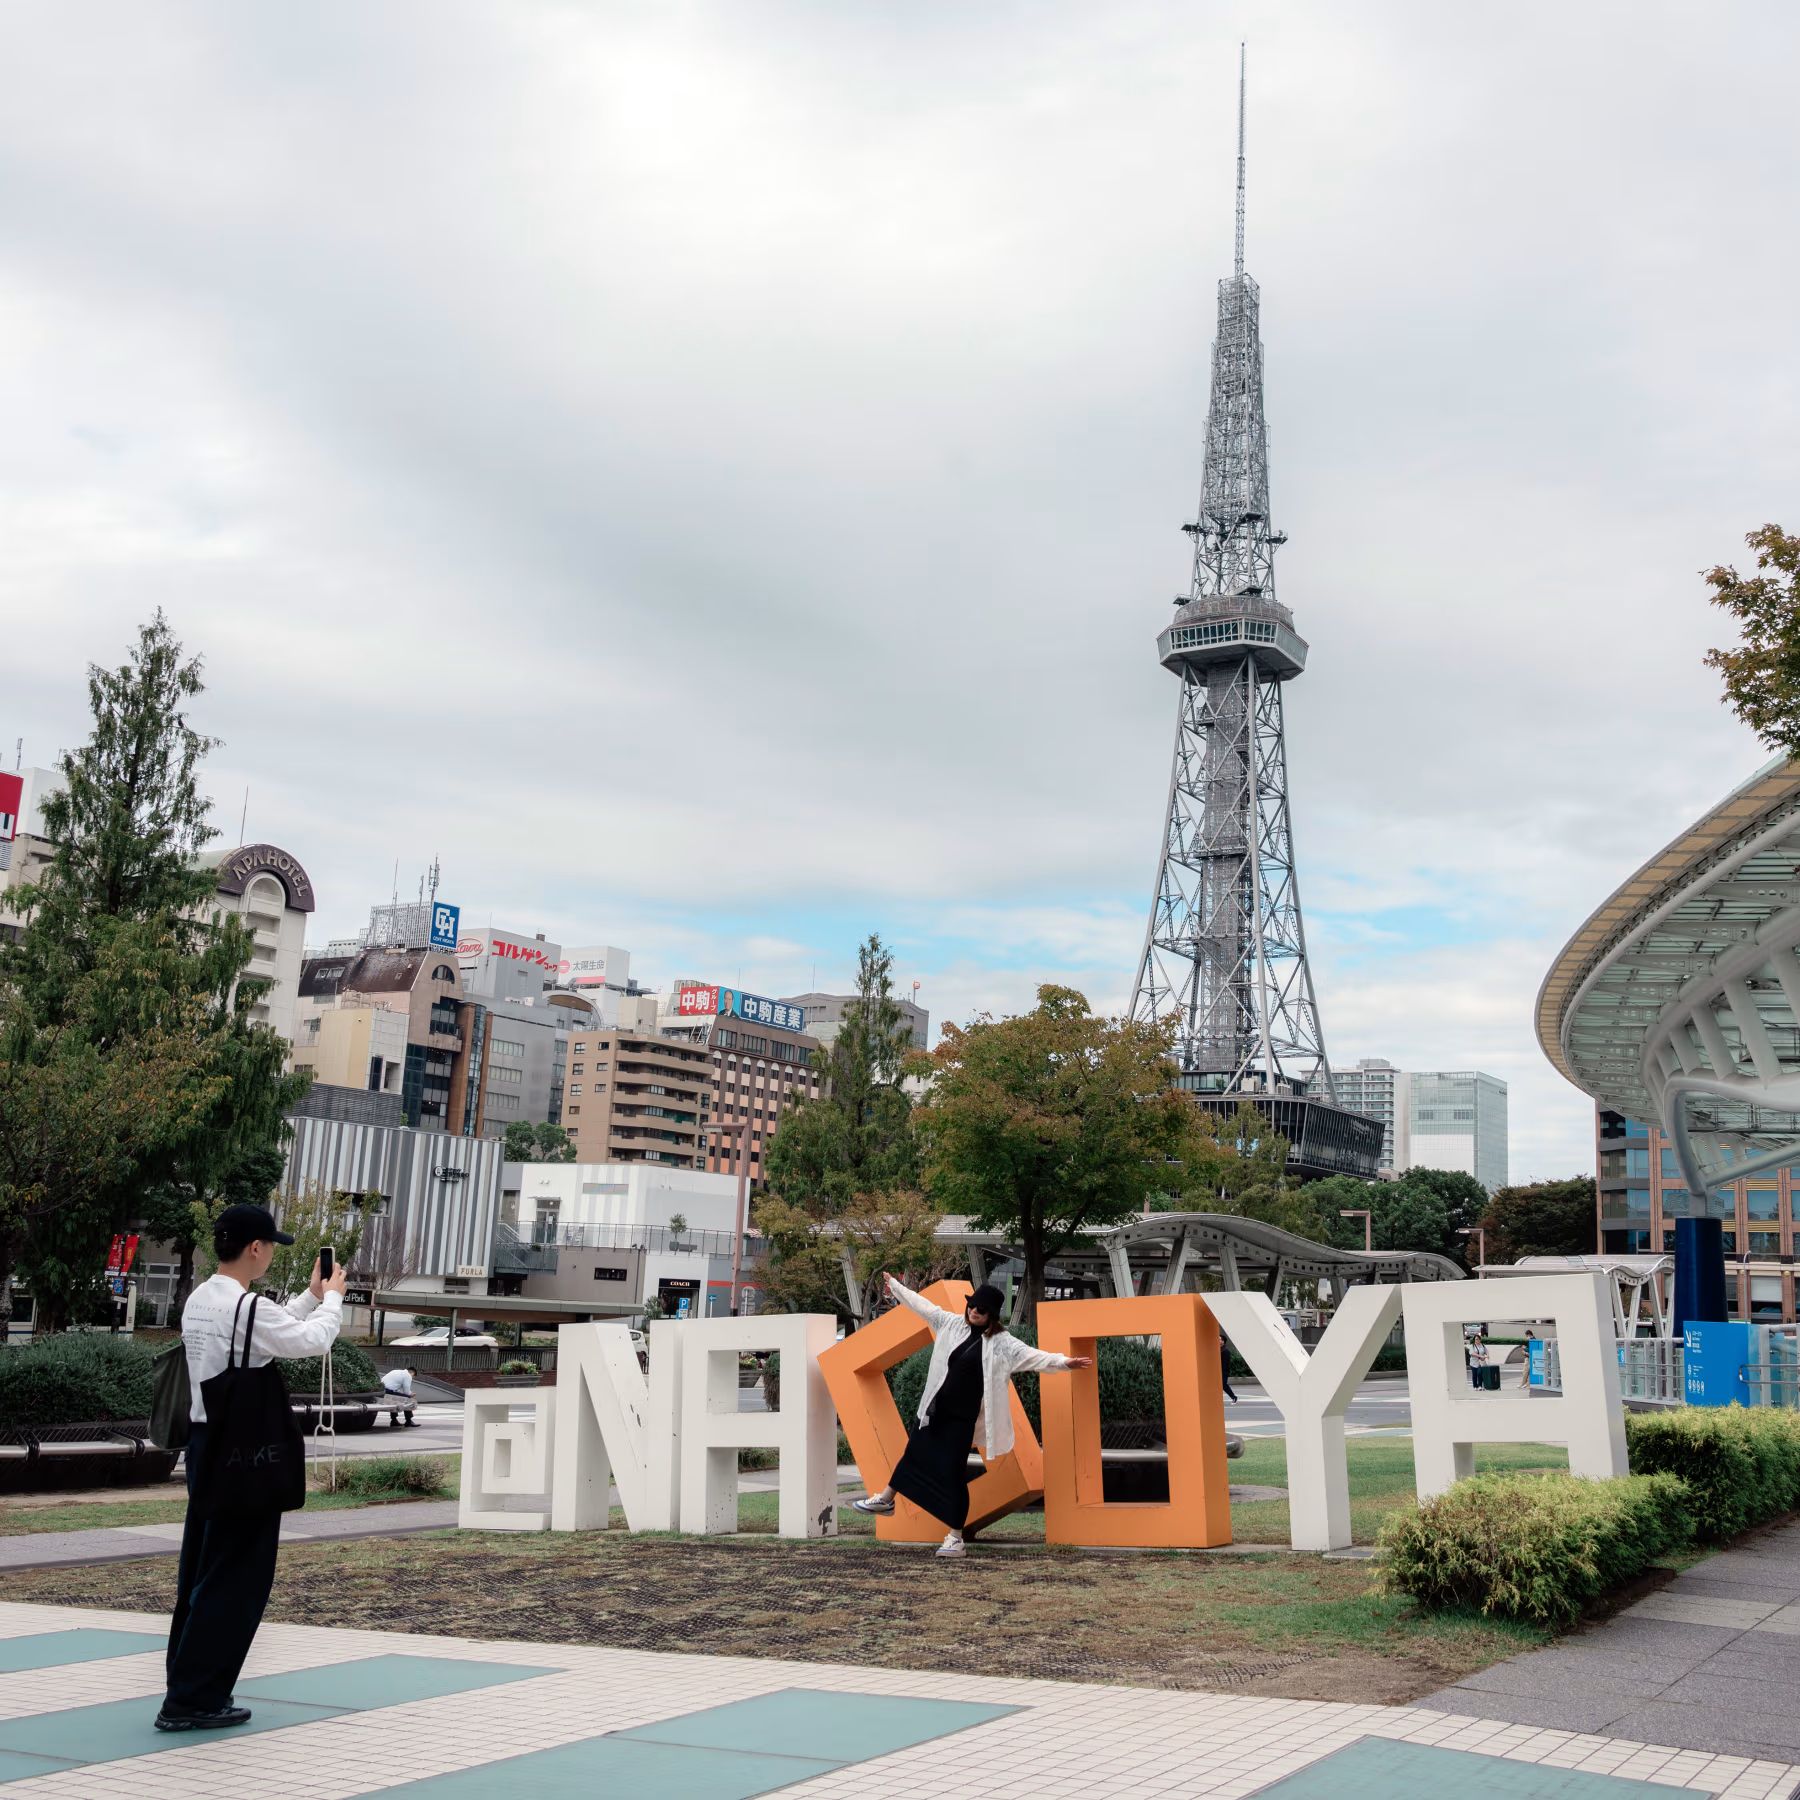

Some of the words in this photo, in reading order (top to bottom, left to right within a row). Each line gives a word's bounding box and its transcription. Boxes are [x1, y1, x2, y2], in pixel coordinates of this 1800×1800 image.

[233, 851, 264, 880] APA
[267, 849, 308, 896] HOTEL
[681, 990, 710, 1011] 中駒
[744, 997, 801, 1028] 中駒産業
[460, 1267, 483, 1276] FURLA
